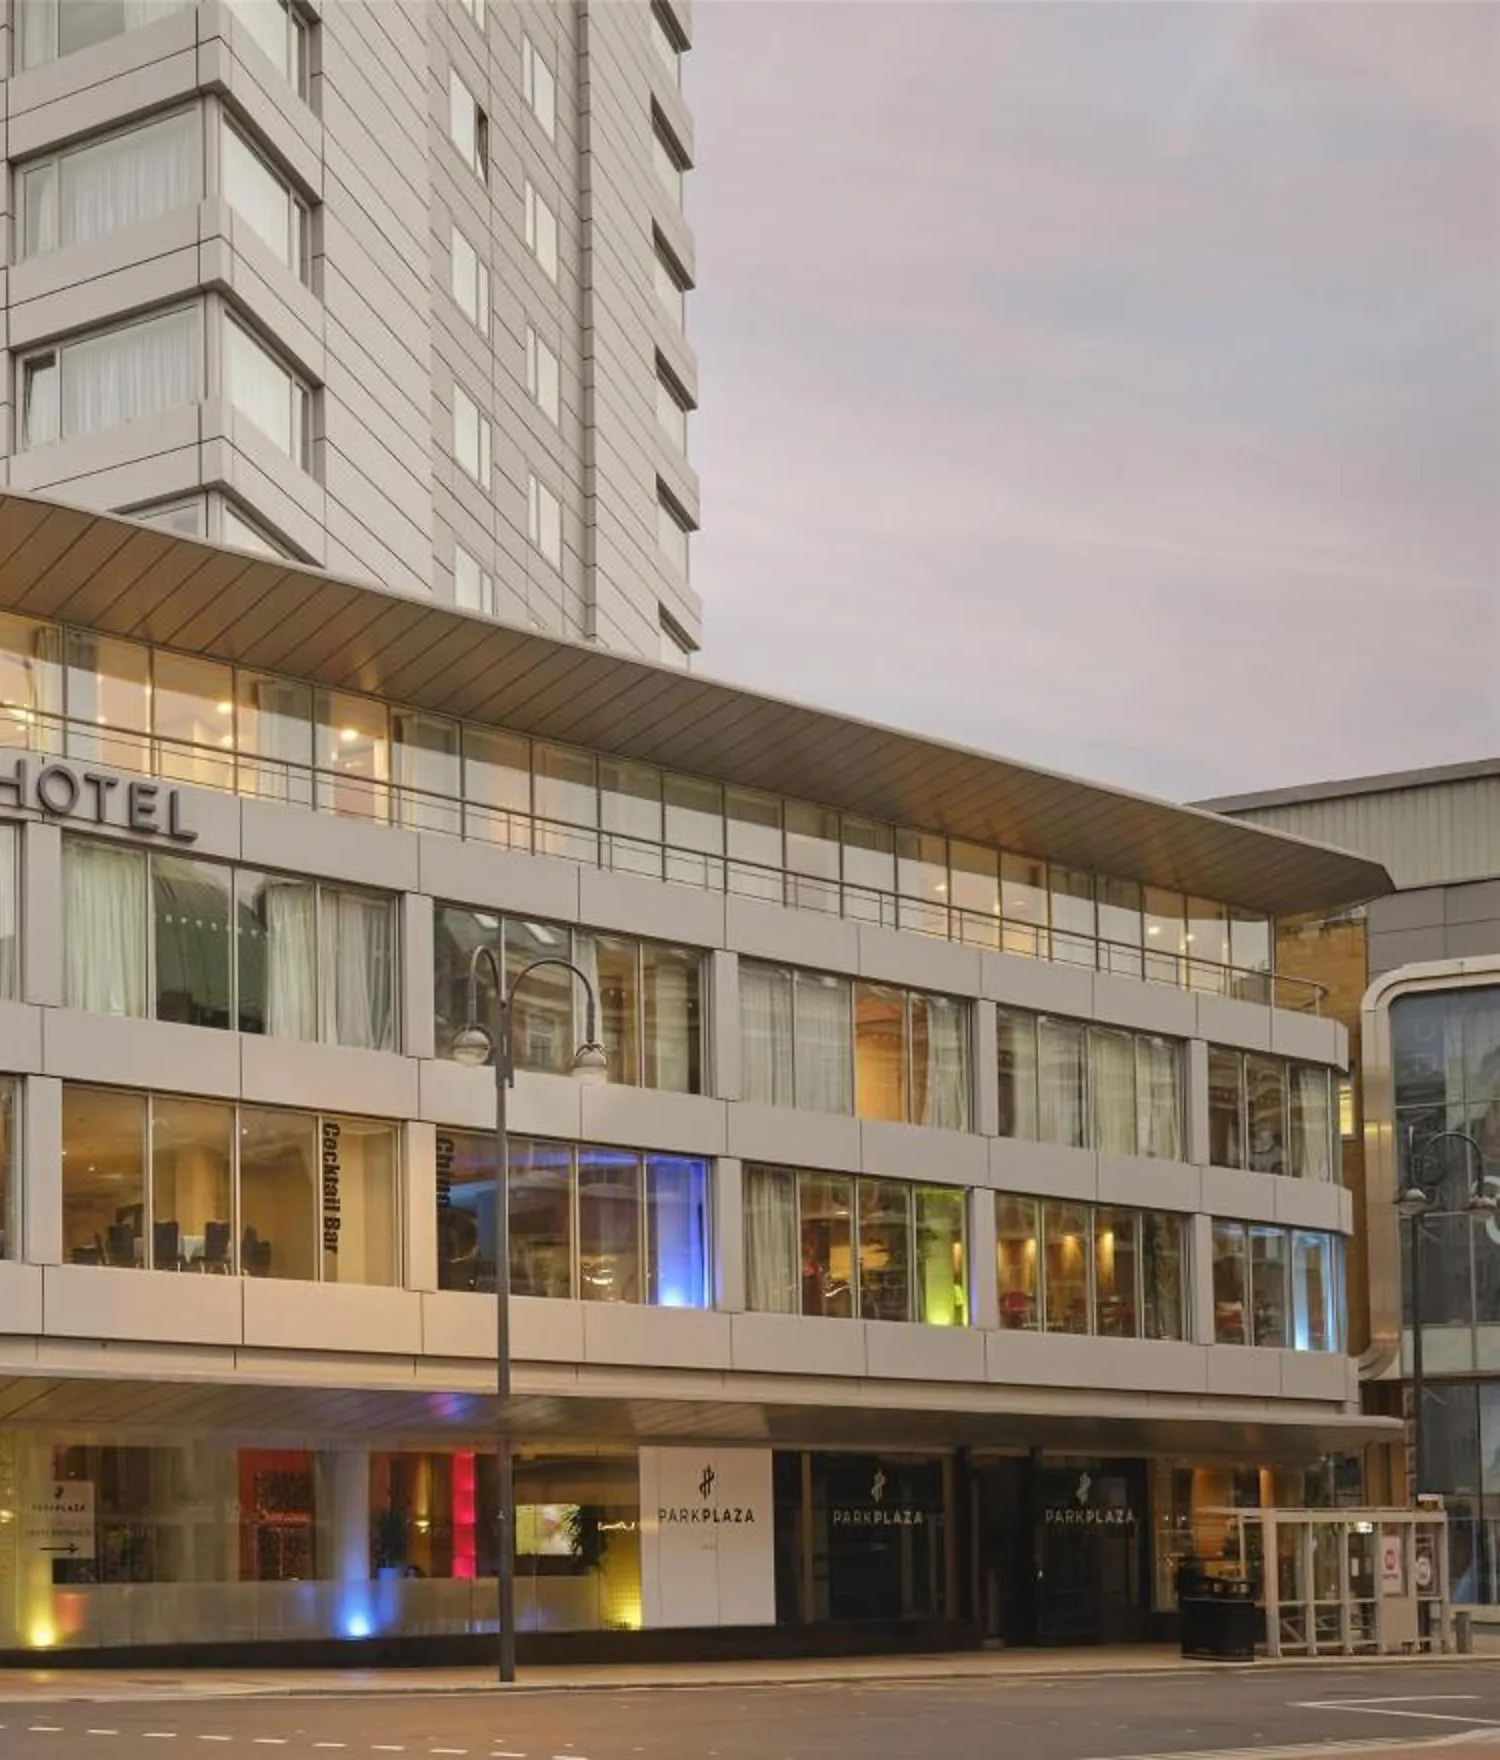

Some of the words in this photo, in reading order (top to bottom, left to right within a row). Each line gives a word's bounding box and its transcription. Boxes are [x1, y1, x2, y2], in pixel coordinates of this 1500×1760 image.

[323, 1123, 341, 1212] Cocktail
[323, 1216, 341, 1254] Bar
[659, 1507, 755, 1523] PARKPLAZA
[833, 1509, 923, 1525] PARKPLAZA
[1045, 1508, 1134, 1524] PARKPLAZA
